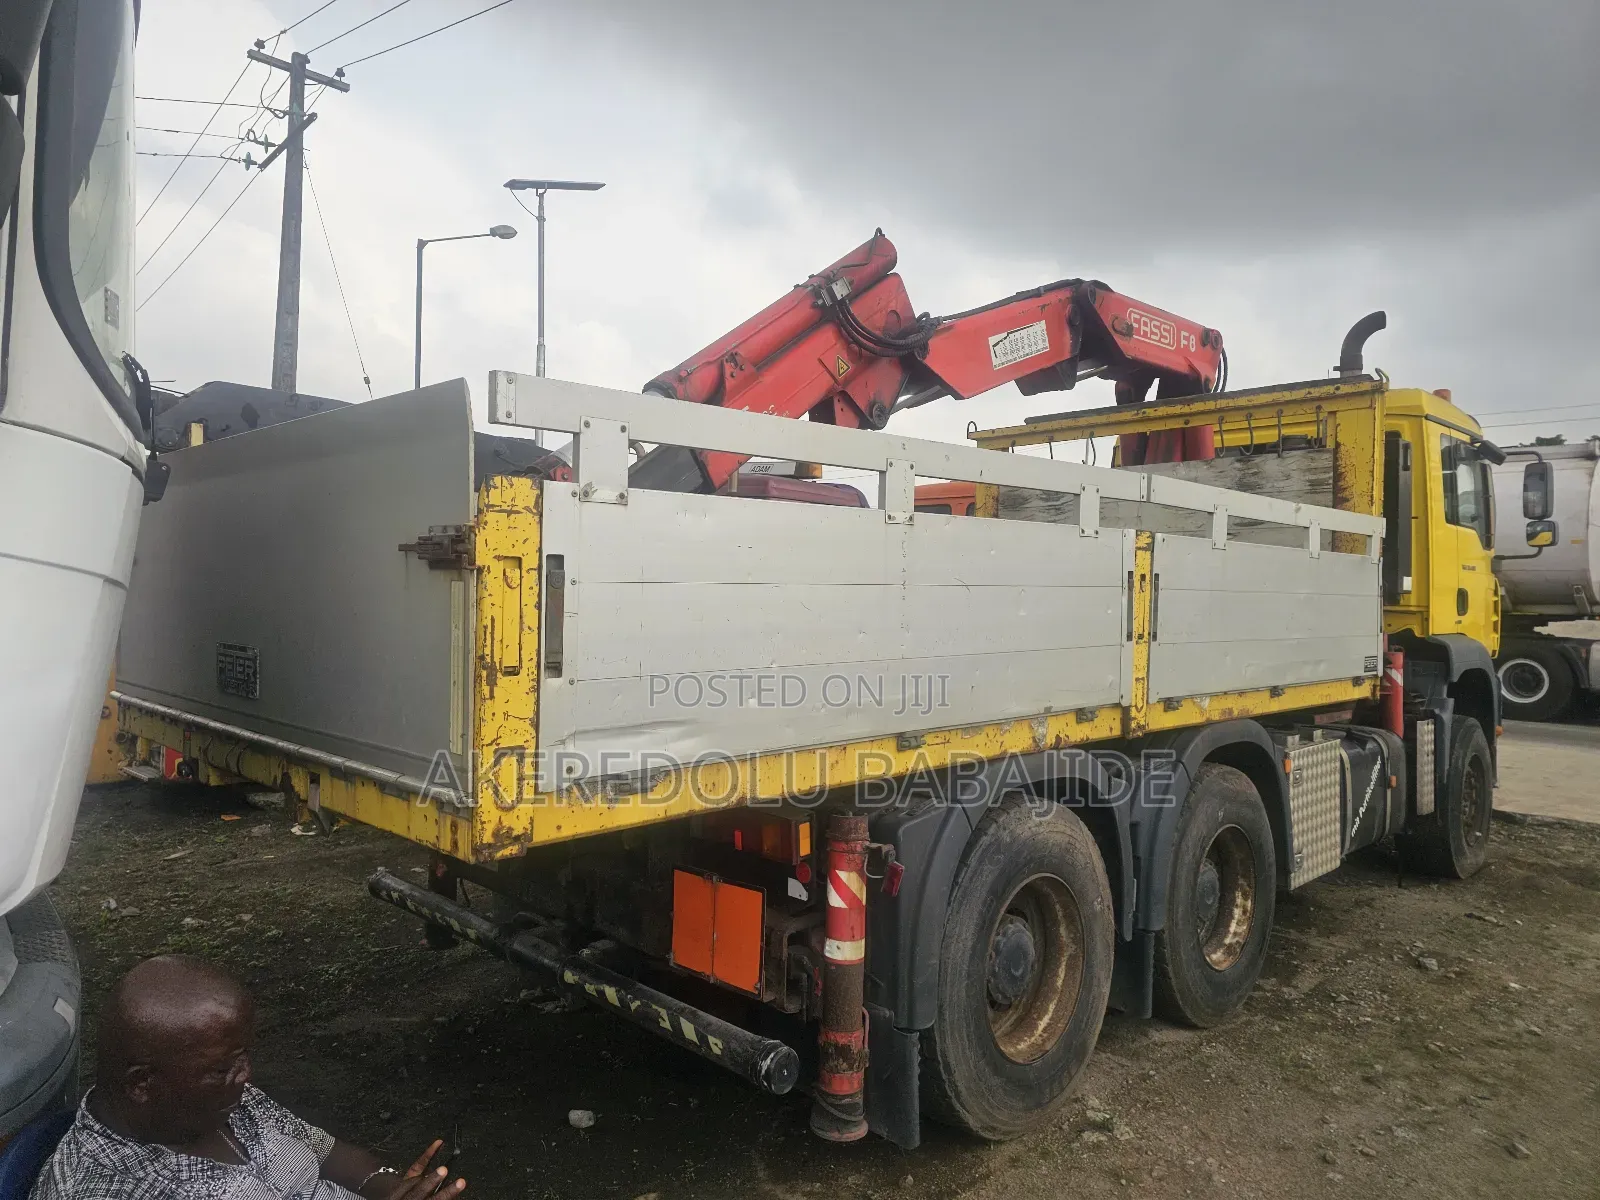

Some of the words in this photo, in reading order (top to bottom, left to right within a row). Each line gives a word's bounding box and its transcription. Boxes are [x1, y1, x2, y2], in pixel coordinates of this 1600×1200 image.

[1131, 312, 1174, 346] FASSI
[1181, 330, 1196, 352] F8
[751, 465, 771, 473] ADAM
